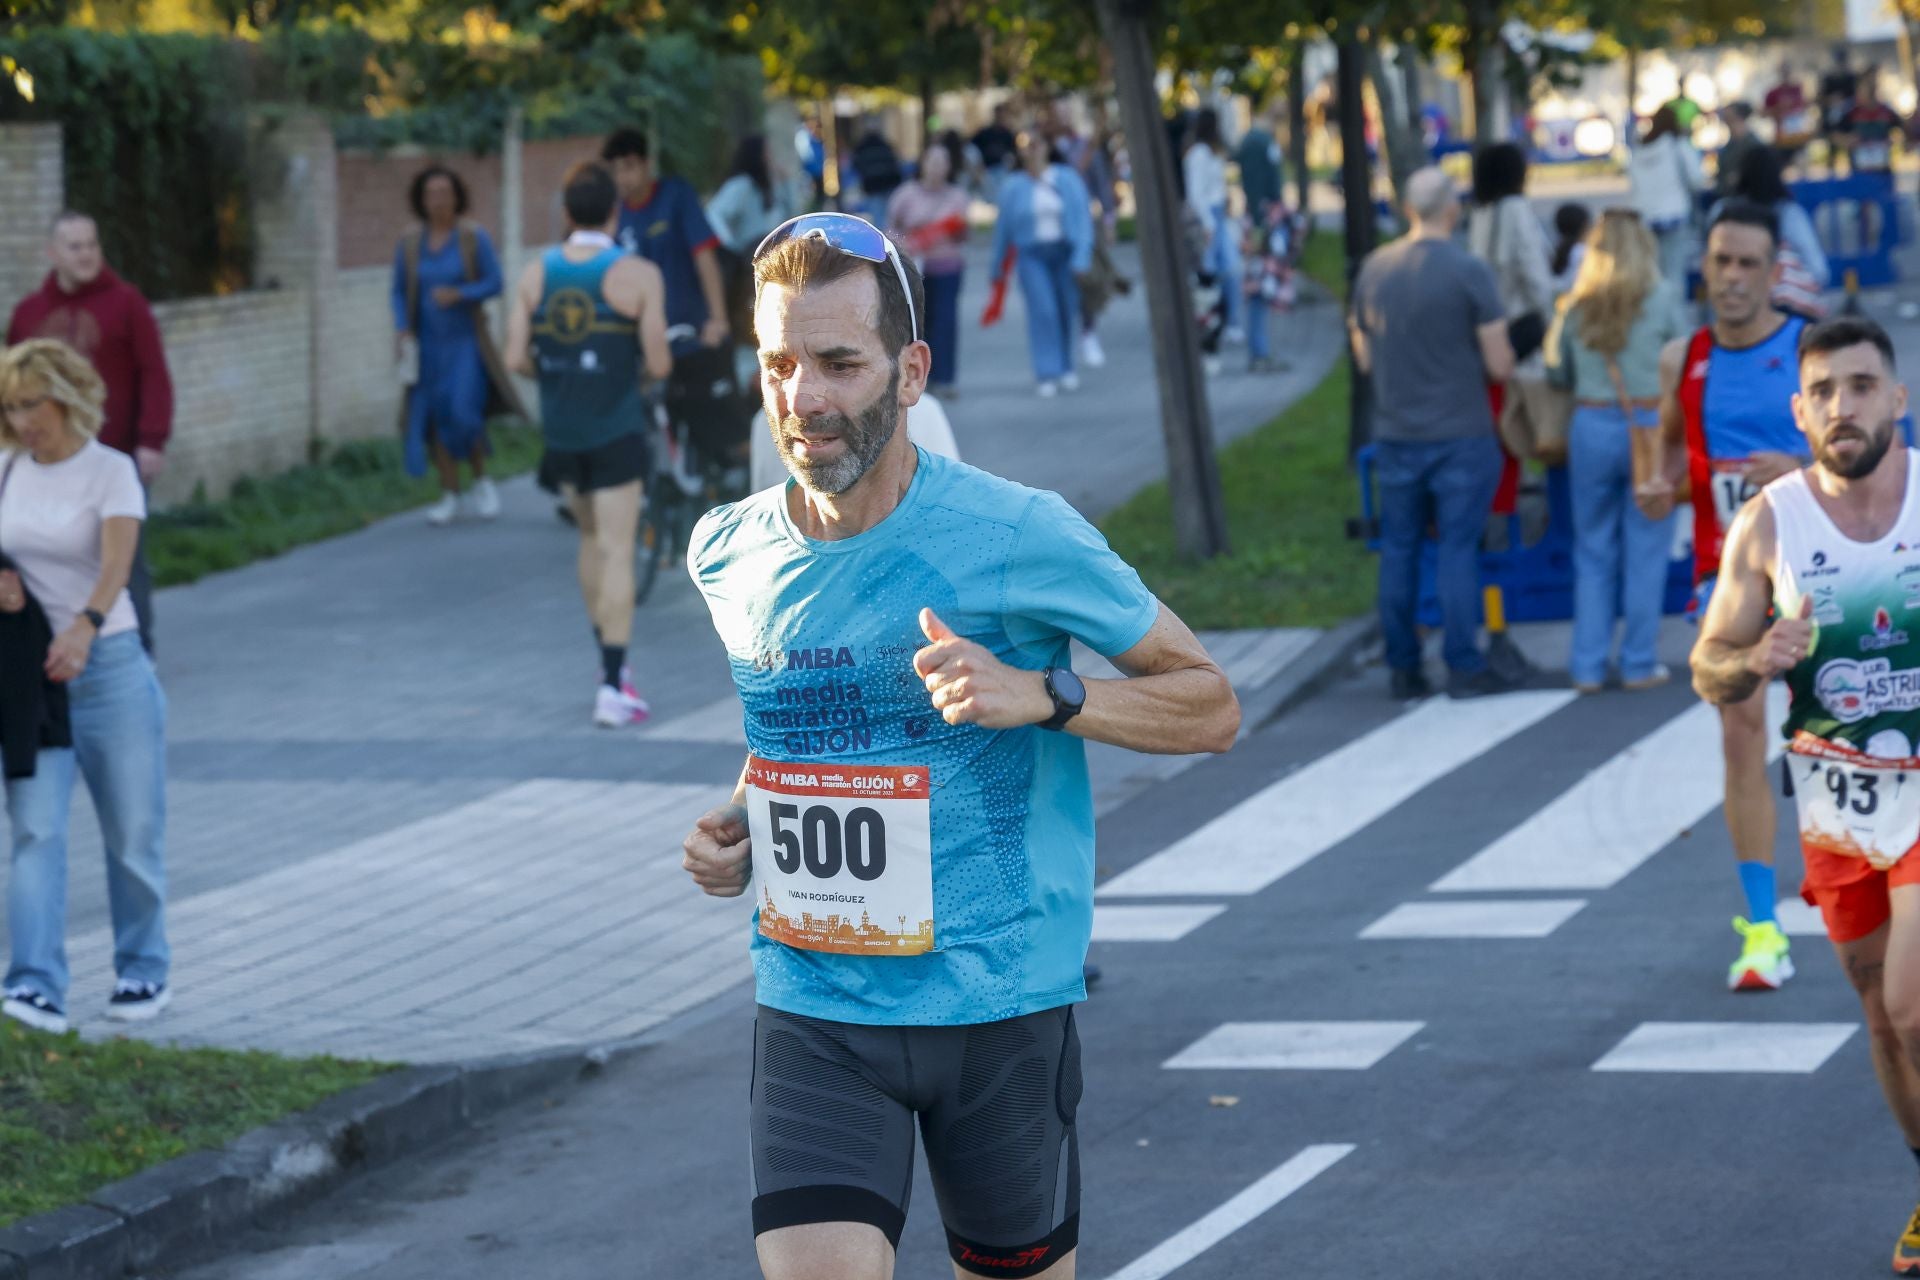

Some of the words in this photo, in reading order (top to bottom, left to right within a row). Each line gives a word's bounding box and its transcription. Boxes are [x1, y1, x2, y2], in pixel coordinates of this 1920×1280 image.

[788, 646, 857, 671] MBA
[776, 679, 862, 706] media
[1865, 671, 1920, 700] ASTRI
[780, 773, 819, 787] MBA
[821, 781, 852, 789] maratón
[822, 774, 844, 782] media
[852, 774, 895, 790] GIJÓN
[1826, 765, 1879, 815] 93
[769, 800, 887, 881] 500
[788, 889, 808, 900] IVAN
[809, 892, 865, 904] RODRÍGUEZ
